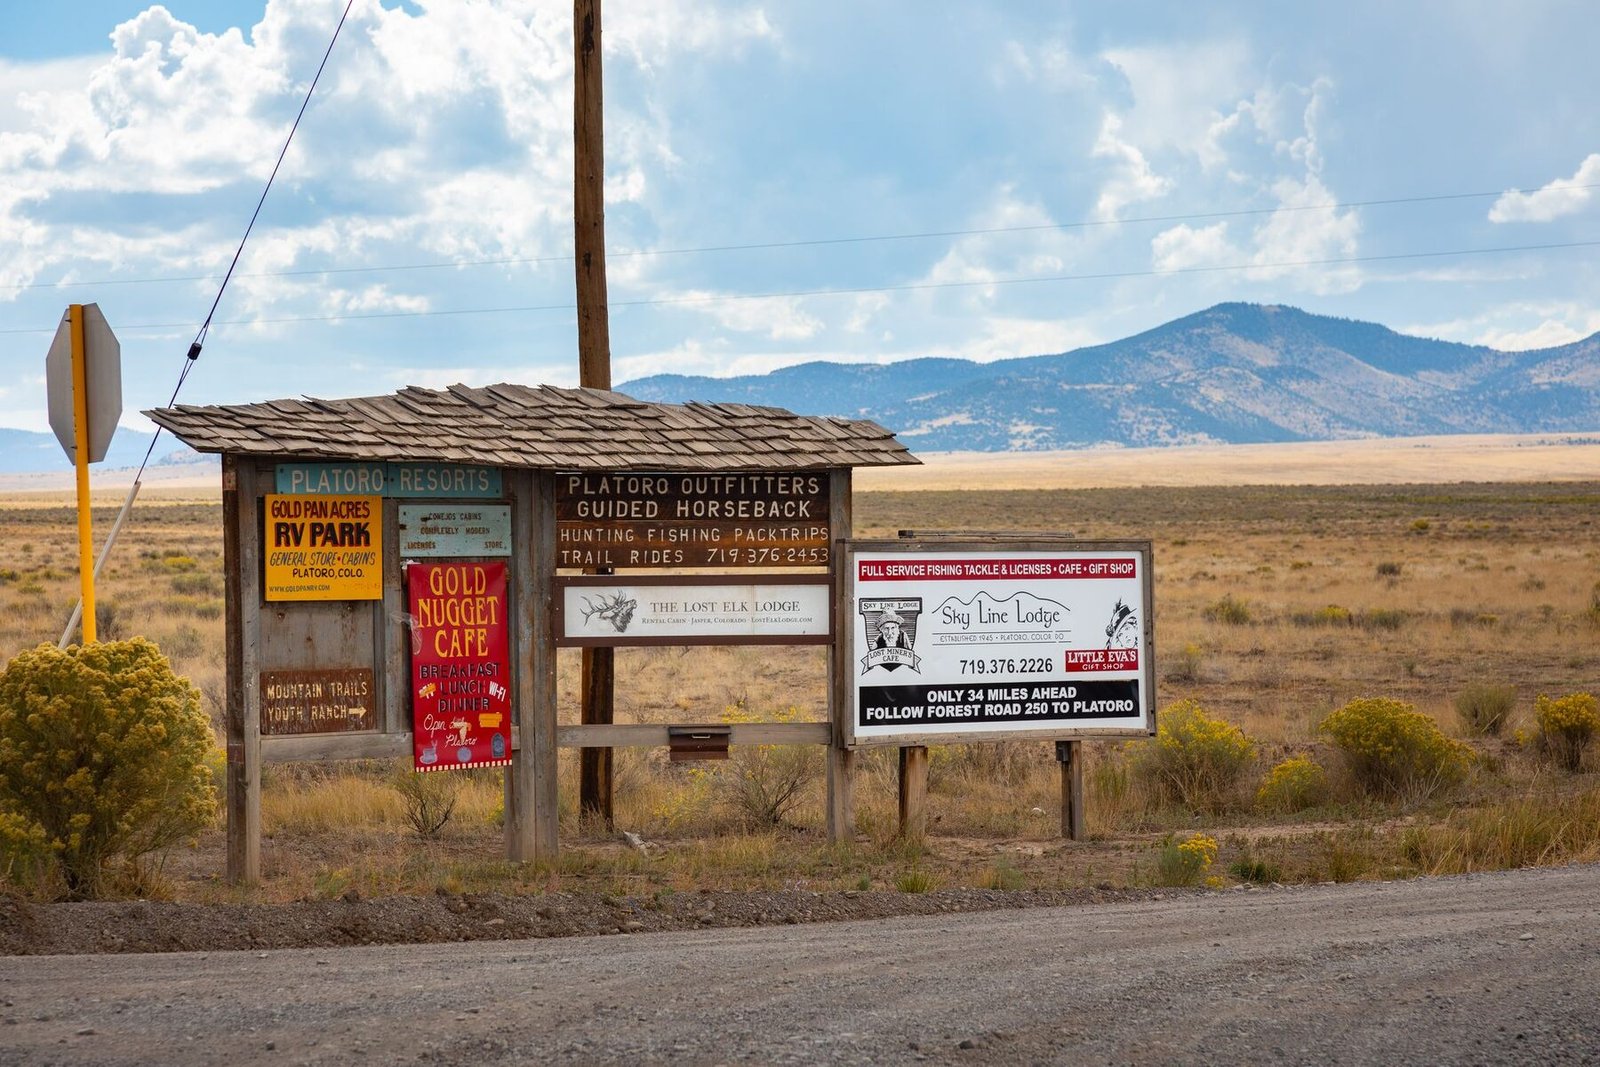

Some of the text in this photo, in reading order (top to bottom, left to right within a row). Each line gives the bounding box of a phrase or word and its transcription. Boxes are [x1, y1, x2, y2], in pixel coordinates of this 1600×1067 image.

[291, 468, 489, 493] PLATORO RESORTS
[568, 476, 820, 496] PLATORO OUTFITTERS
[271, 500, 371, 519] GOLD PAN ACRES
[428, 512, 482, 521] CONEJOS CABINS
[577, 500, 811, 518] GUIDED HORSEBACK
[274, 521, 371, 548] RV PARK
[420, 526, 490, 535] COMPLETELY MODERN
[560, 527, 829, 542] HUNTING FISHING PACKTRIPS
[484, 541, 503, 549] STORE
[269, 551, 376, 567] GENERAL STORE CABINS
[561, 550, 613, 564] TRAIL
[630, 549, 684, 564] RIDES
[292, 568, 365, 579] PLATORO, COLO.
[861, 562, 1134, 577] FULL SERVICE FISHING TACKLE & LICENSES CAFE GIFT SHOP
[429, 566, 486, 596] GOLD
[417, 596, 499, 628] NUGGET
[650, 600, 801, 613] THE LOST ELK LODGE
[942, 599, 1060, 630] Sky Line Lodge
[434, 628, 489, 658] CAFE
[869, 649, 885, 659] LOST
[1067, 650, 1137, 664] LITTLE EVA'S
[419, 661, 500, 679] BREAKFAST
[960, 658, 1053, 675] 719.376.2226
[267, 681, 368, 700] MOUNTAIN TRAILS
[439, 679, 486, 696] LUNCH
[926, 687, 1077, 703] ONLY 34 MILES AHEAD
[267, 704, 348, 721] YOUTH RANCH
[437, 697, 489, 713] DINNER
[866, 700, 1134, 720] FOLLOW FOREST ROAD 250 TO PLATORO
[423, 713, 447, 739] Open
[444, 733, 478, 749] Plaoro
